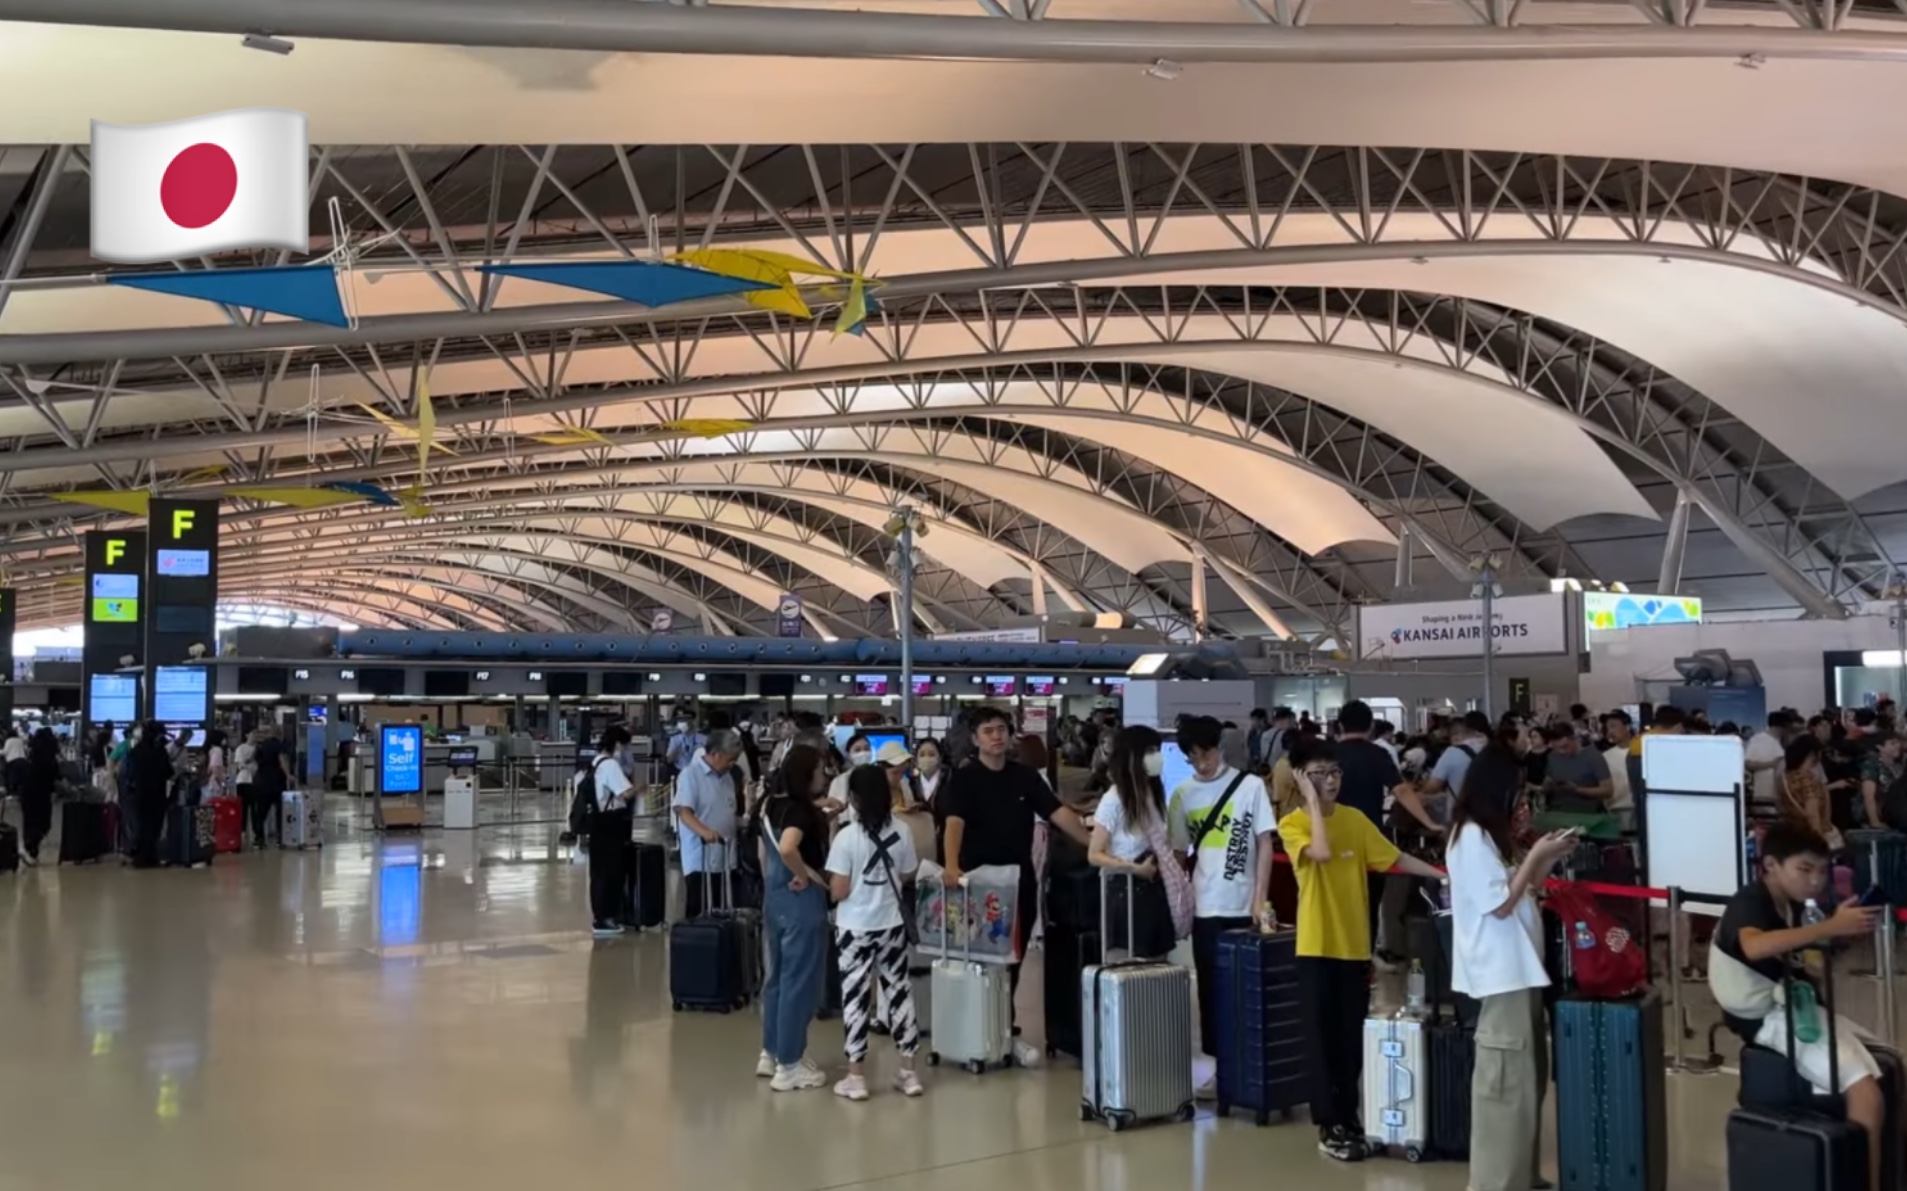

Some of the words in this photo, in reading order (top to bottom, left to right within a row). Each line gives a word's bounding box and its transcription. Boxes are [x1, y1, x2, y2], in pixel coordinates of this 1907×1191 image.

[173, 510, 195, 539] F
[106, 540, 125, 565] F
[1403, 627, 1454, 642] KANSAI
[295, 670, 309, 680] F15
[476, 671, 490, 681] F17
[1515, 684, 1524, 703] F
[389, 753, 413, 764] Self
[1223, 818, 1242, 880] DESTROY
